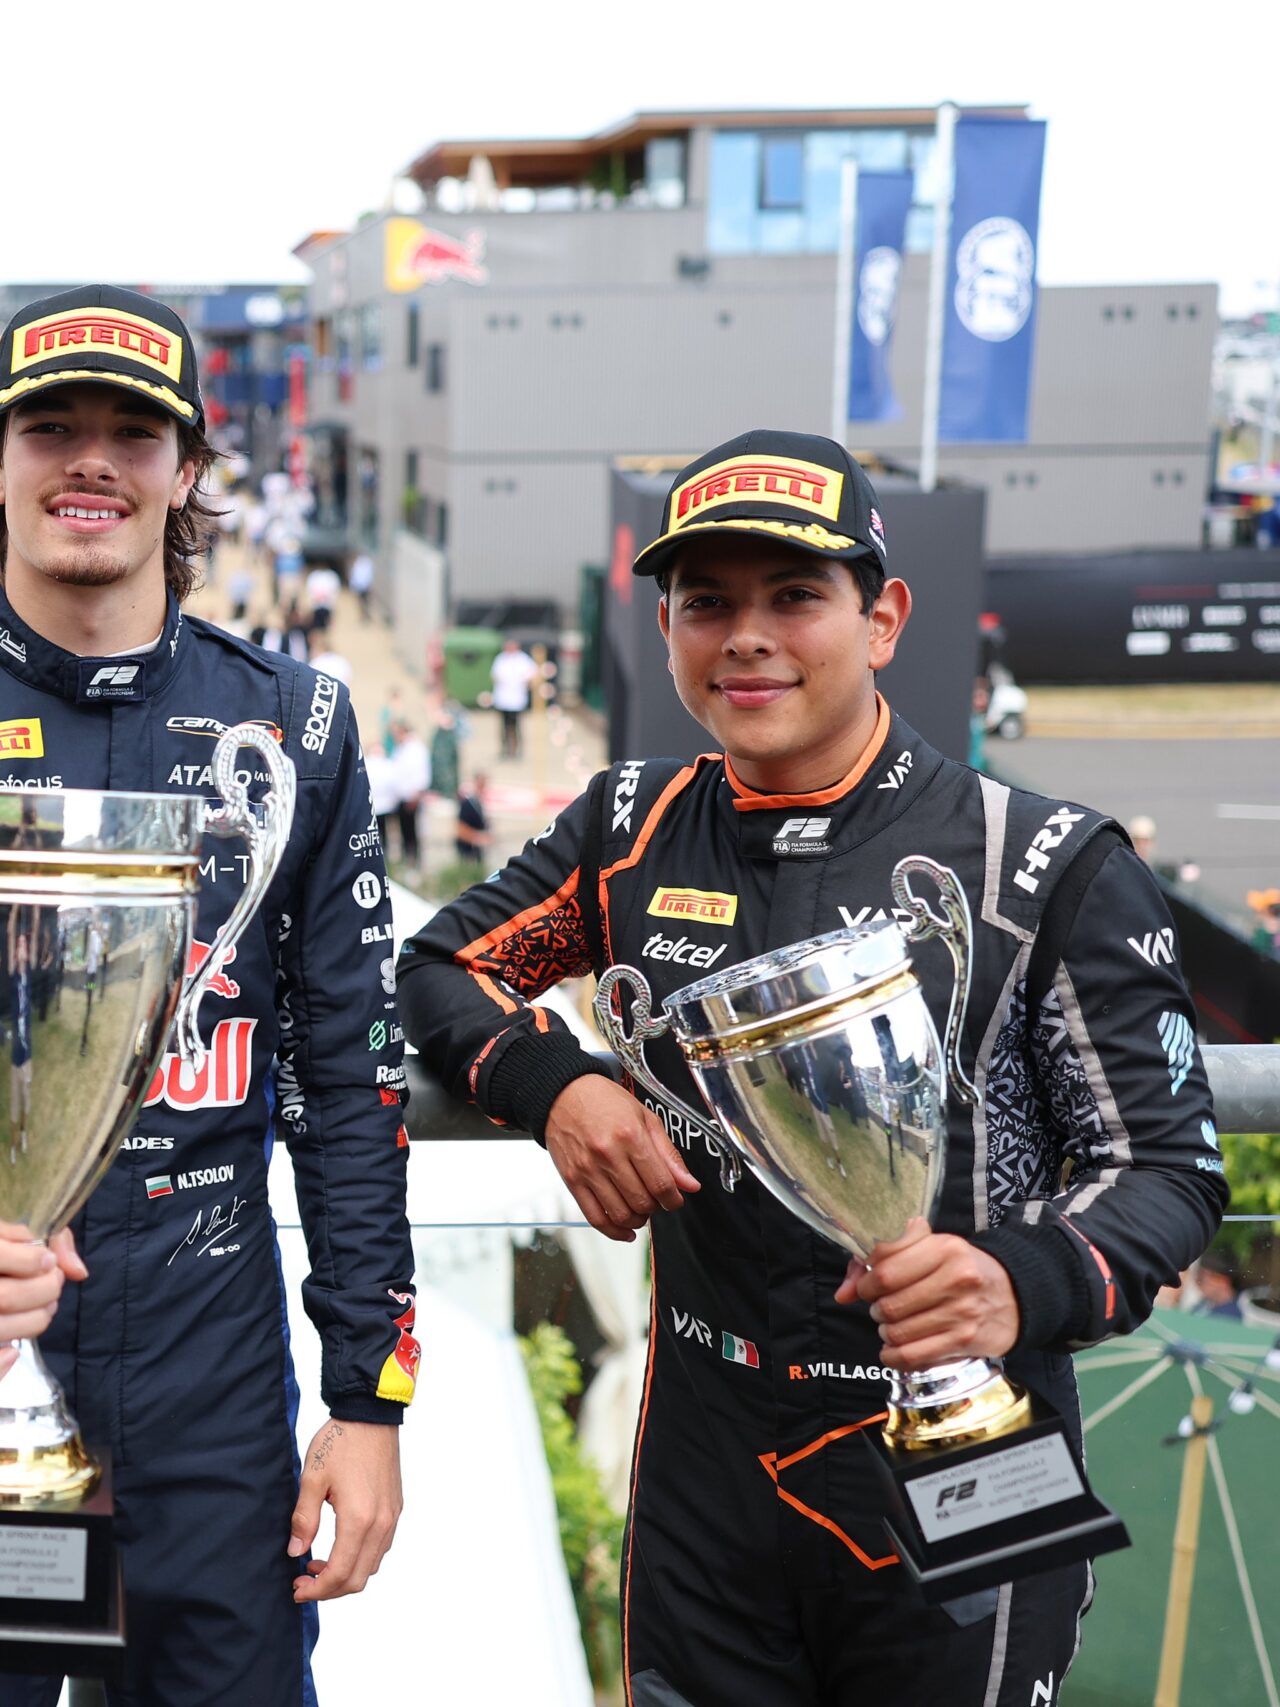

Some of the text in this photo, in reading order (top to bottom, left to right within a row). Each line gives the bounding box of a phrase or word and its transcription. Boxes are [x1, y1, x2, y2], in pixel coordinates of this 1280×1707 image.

[24, 316, 171, 366] PIRELLI
[676, 464, 828, 520] PIRELLI
[89, 665, 140, 685] F2
[301, 674, 338, 755] sparco
[167, 764, 252, 788] ATAO
[612, 760, 647, 834] HRX
[776, 817, 832, 838] F2
[773, 840, 790, 853] FIA
[1012, 807, 1086, 894] HRX
[357, 879, 377, 901] H
[658, 893, 730, 918] PIRELLI
[641, 932, 727, 969] telcel
[376, 1064, 405, 1083] Race
[120, 1137, 175, 1150] ADES
[177, 1164, 235, 1190] N.TSOLOV
[671, 1306, 713, 1349] VAR
[789, 1362, 894, 1381] R.VILLAGO
[936, 1479, 977, 1508] F2
